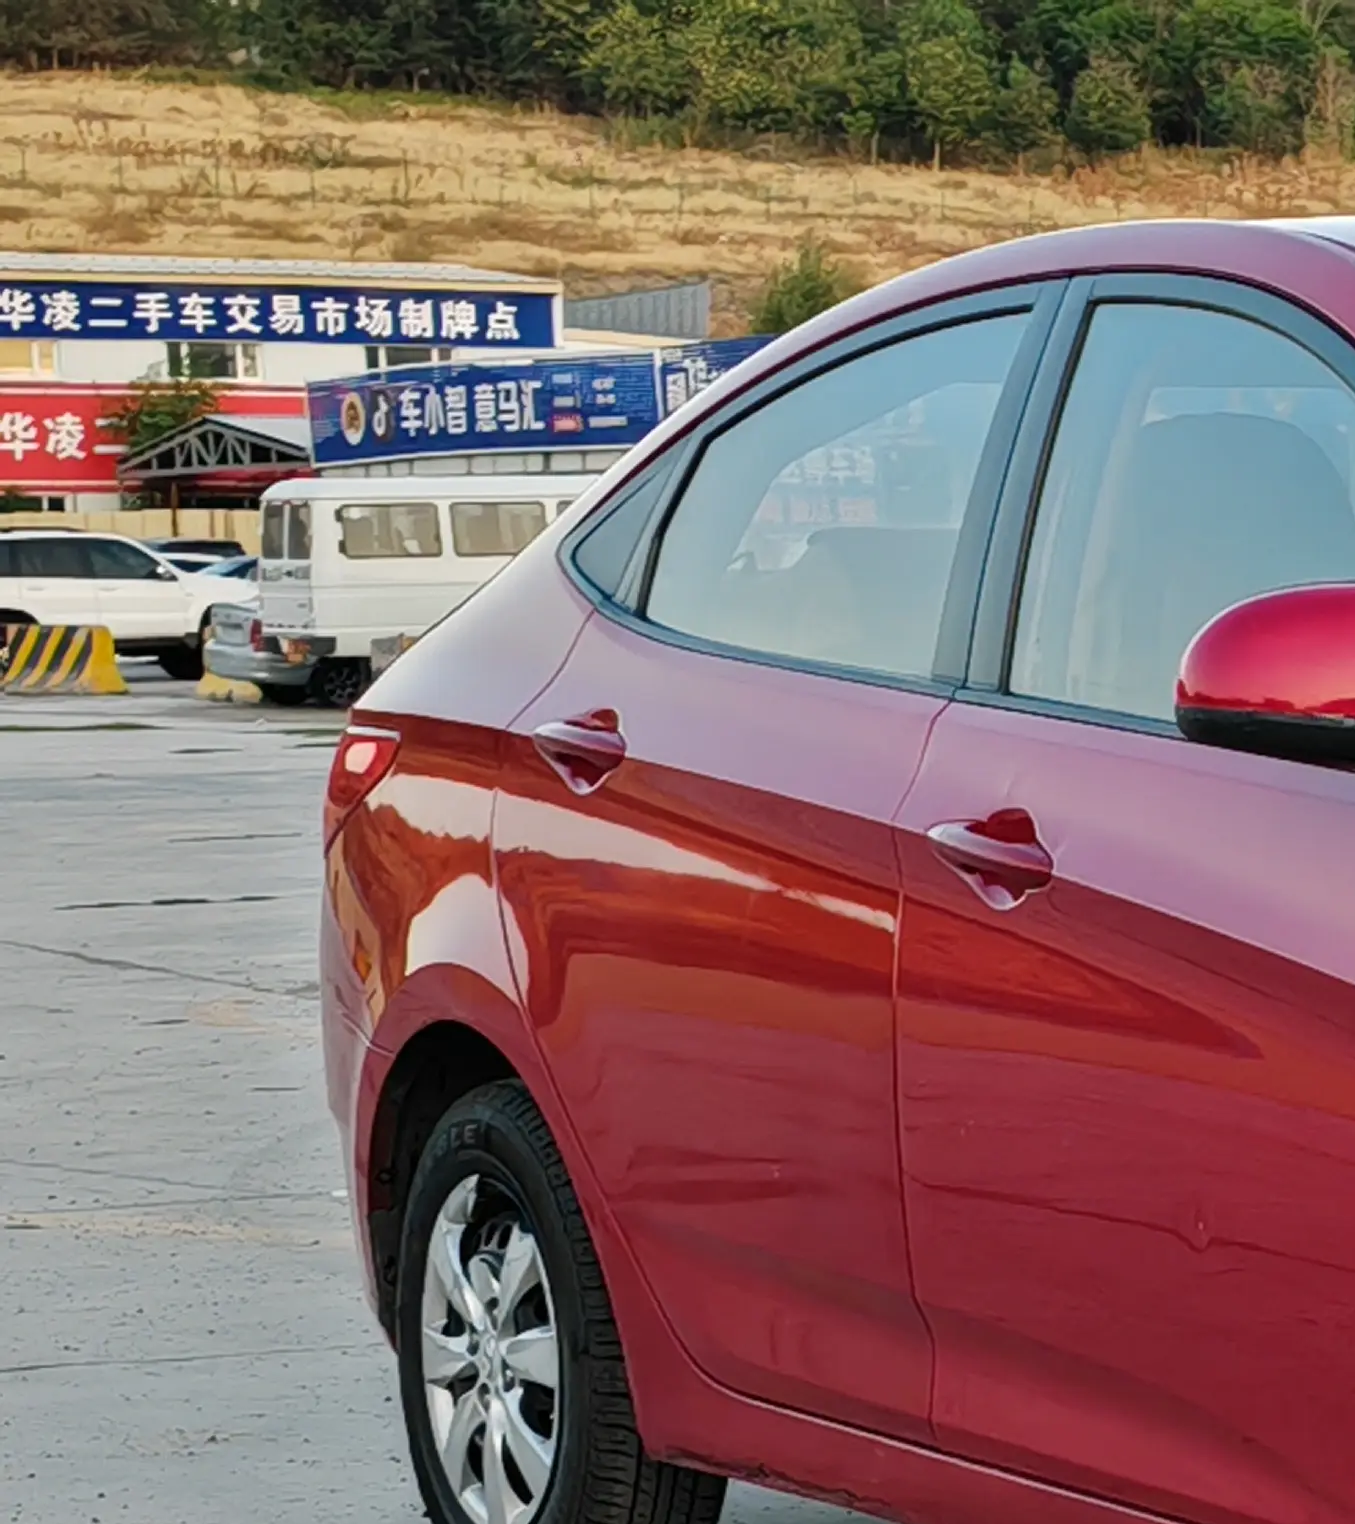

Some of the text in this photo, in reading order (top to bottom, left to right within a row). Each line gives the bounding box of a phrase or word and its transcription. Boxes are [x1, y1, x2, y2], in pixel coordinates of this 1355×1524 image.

[0, 288, 521, 340] 华凌二手车交易市场制牌点
[0, 411, 129, 462] 华凌二
